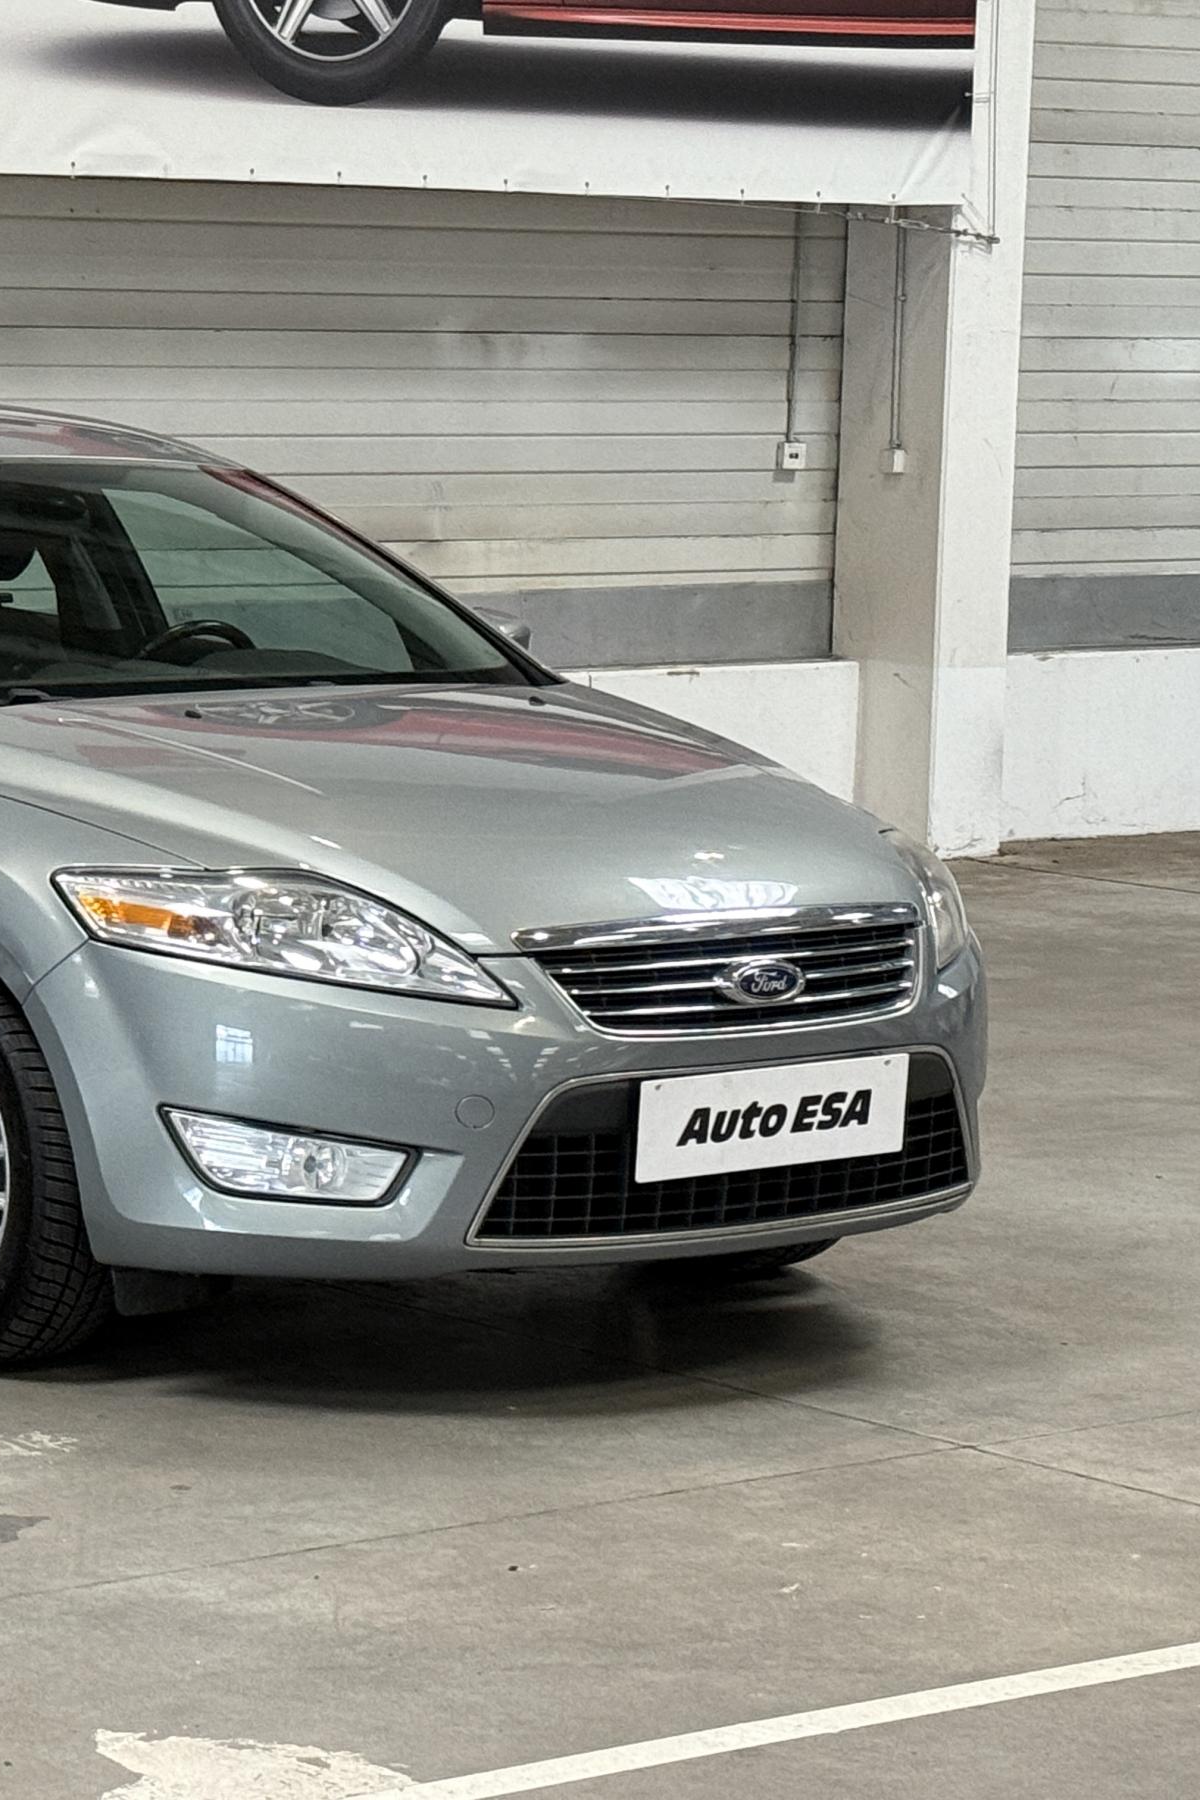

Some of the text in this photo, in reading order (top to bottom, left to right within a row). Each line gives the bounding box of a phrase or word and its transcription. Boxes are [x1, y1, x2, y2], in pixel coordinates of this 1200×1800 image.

[751, 971, 788, 993] Ford
[676, 1089, 872, 1147] Auto ESA
